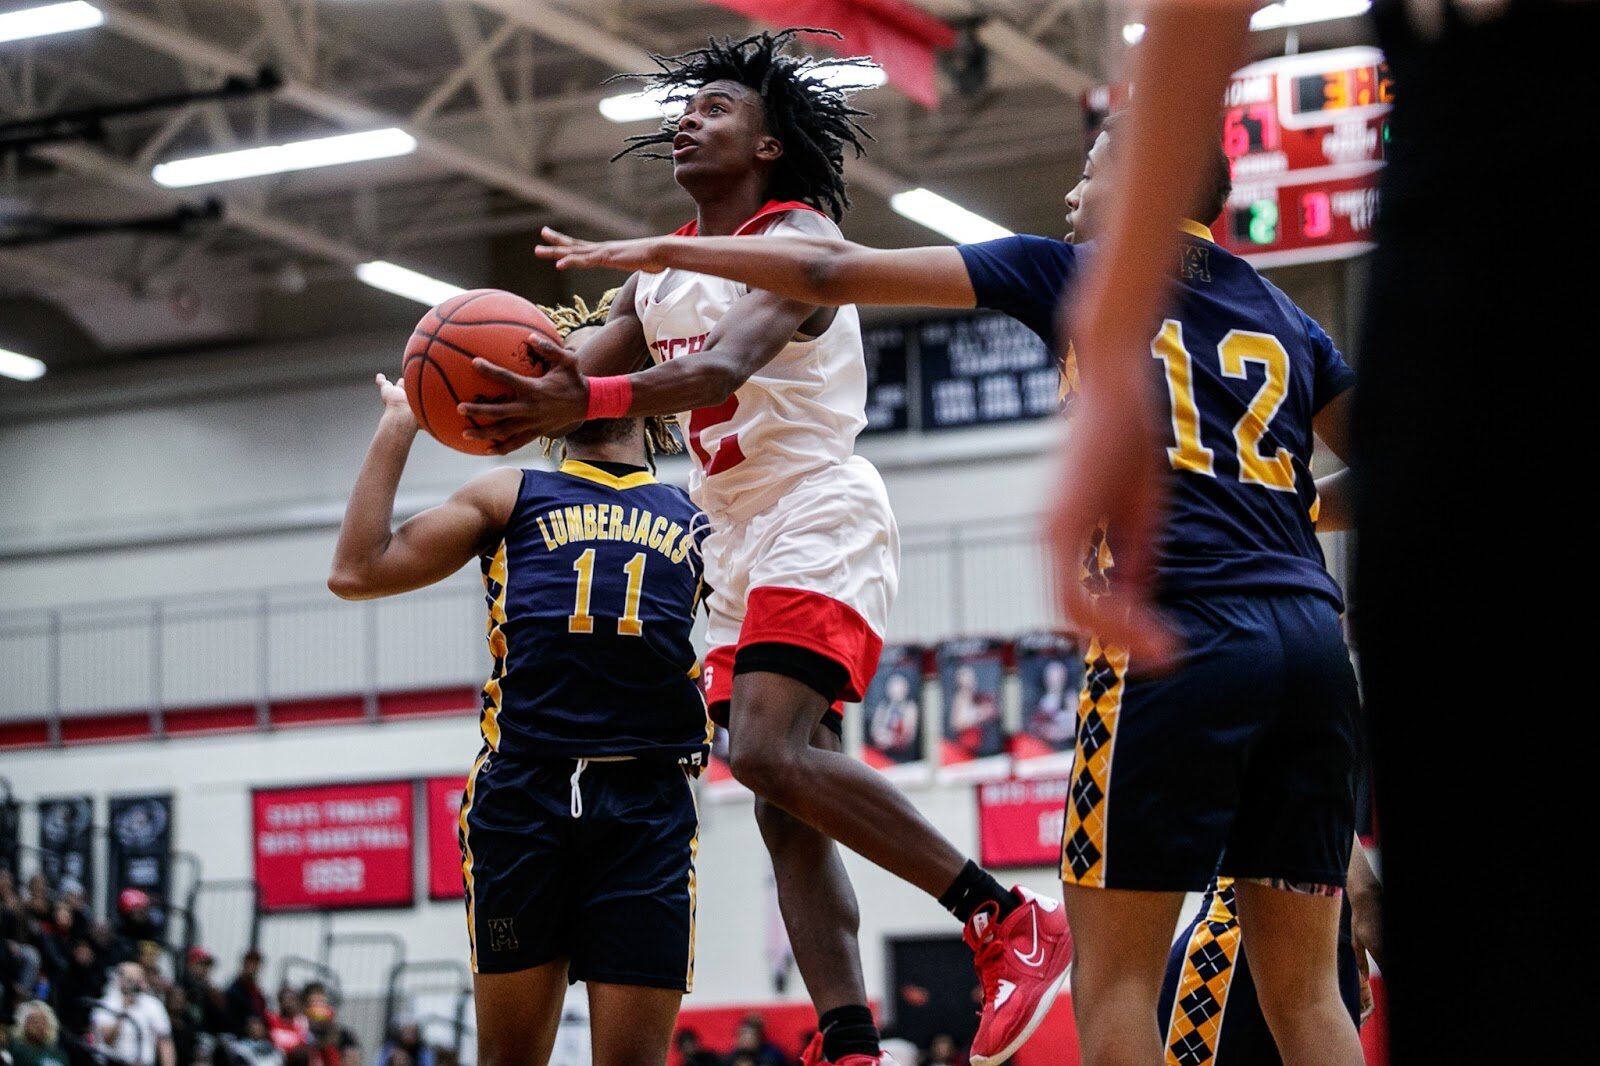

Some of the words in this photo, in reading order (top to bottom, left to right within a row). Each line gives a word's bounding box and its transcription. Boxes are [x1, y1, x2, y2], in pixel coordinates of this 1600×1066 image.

[1150, 317, 1298, 494] 12
[535, 503, 694, 564] LUMBERJACKS
[568, 548, 647, 637] 11
